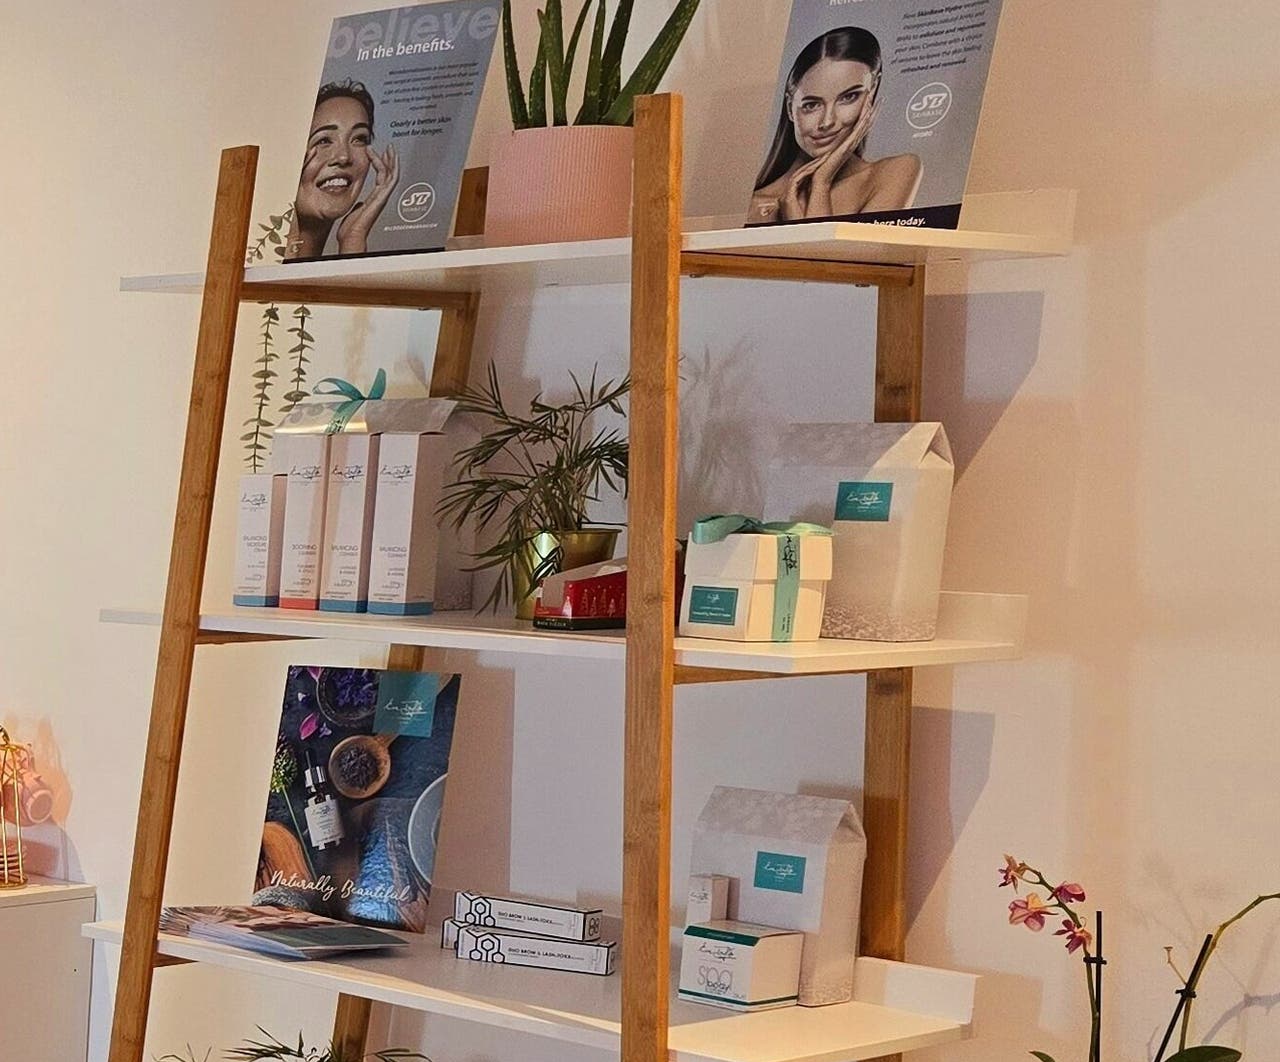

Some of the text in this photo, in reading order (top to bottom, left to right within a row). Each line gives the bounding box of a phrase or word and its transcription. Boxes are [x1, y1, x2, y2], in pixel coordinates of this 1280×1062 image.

[357, 37, 456, 62] In the benefits.
[270, 870, 338, 901] Naturally
[340, 879, 411, 902] Beautiful
